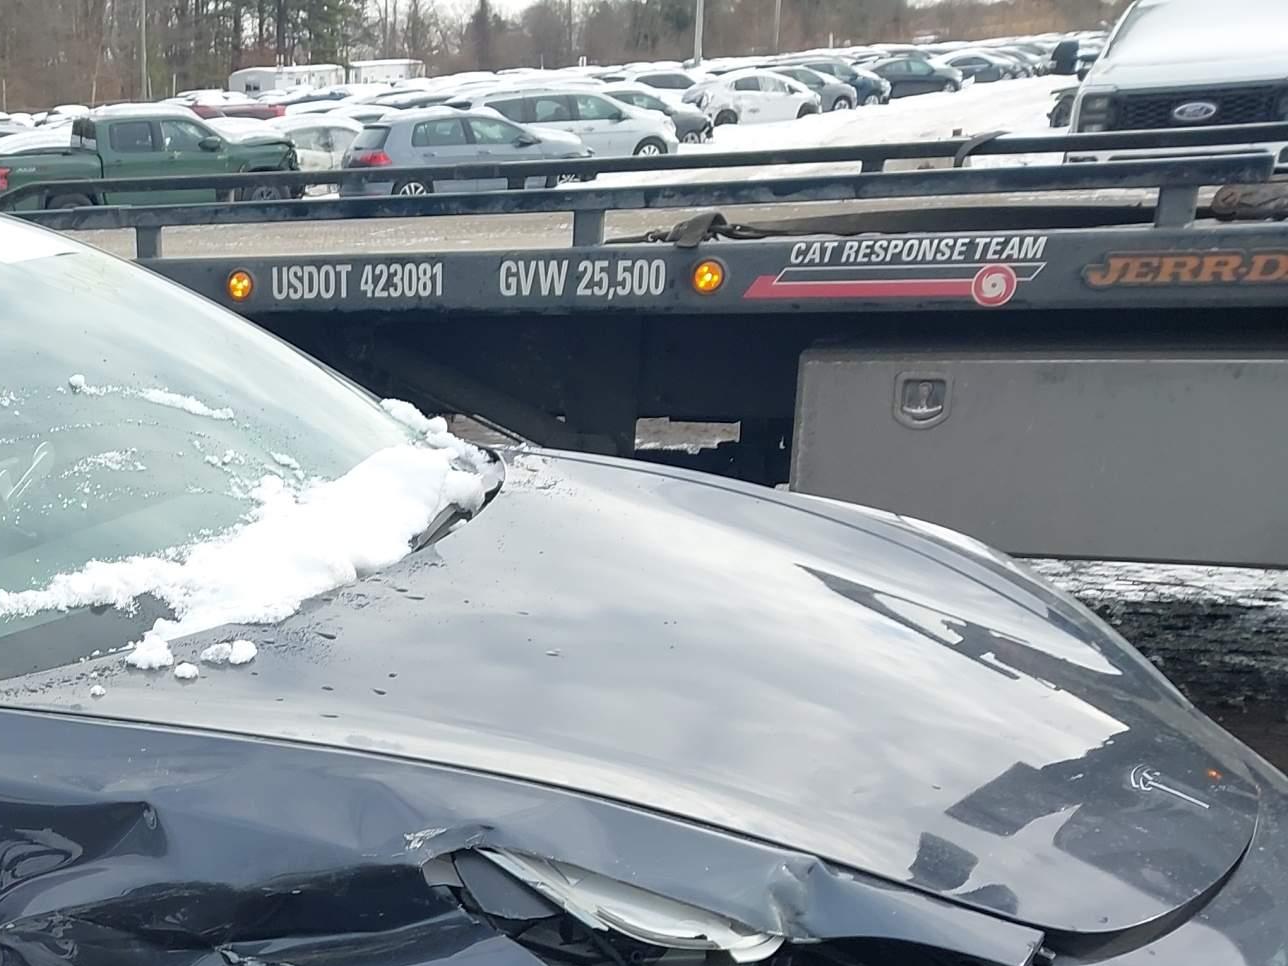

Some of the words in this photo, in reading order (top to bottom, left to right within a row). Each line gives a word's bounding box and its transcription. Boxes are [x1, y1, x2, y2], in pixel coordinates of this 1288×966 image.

[790, 241, 838, 265] CAT
[840, 237, 969, 264] RESPONSE
[974, 236, 1048, 260] TEAM
[271, 264, 352, 300] USDOT
[360, 262, 443, 298] 423081
[499, 259, 569, 296] GVW
[576, 258, 666, 300] 25,500
[1088, 254, 1288, 286] JERR-D
